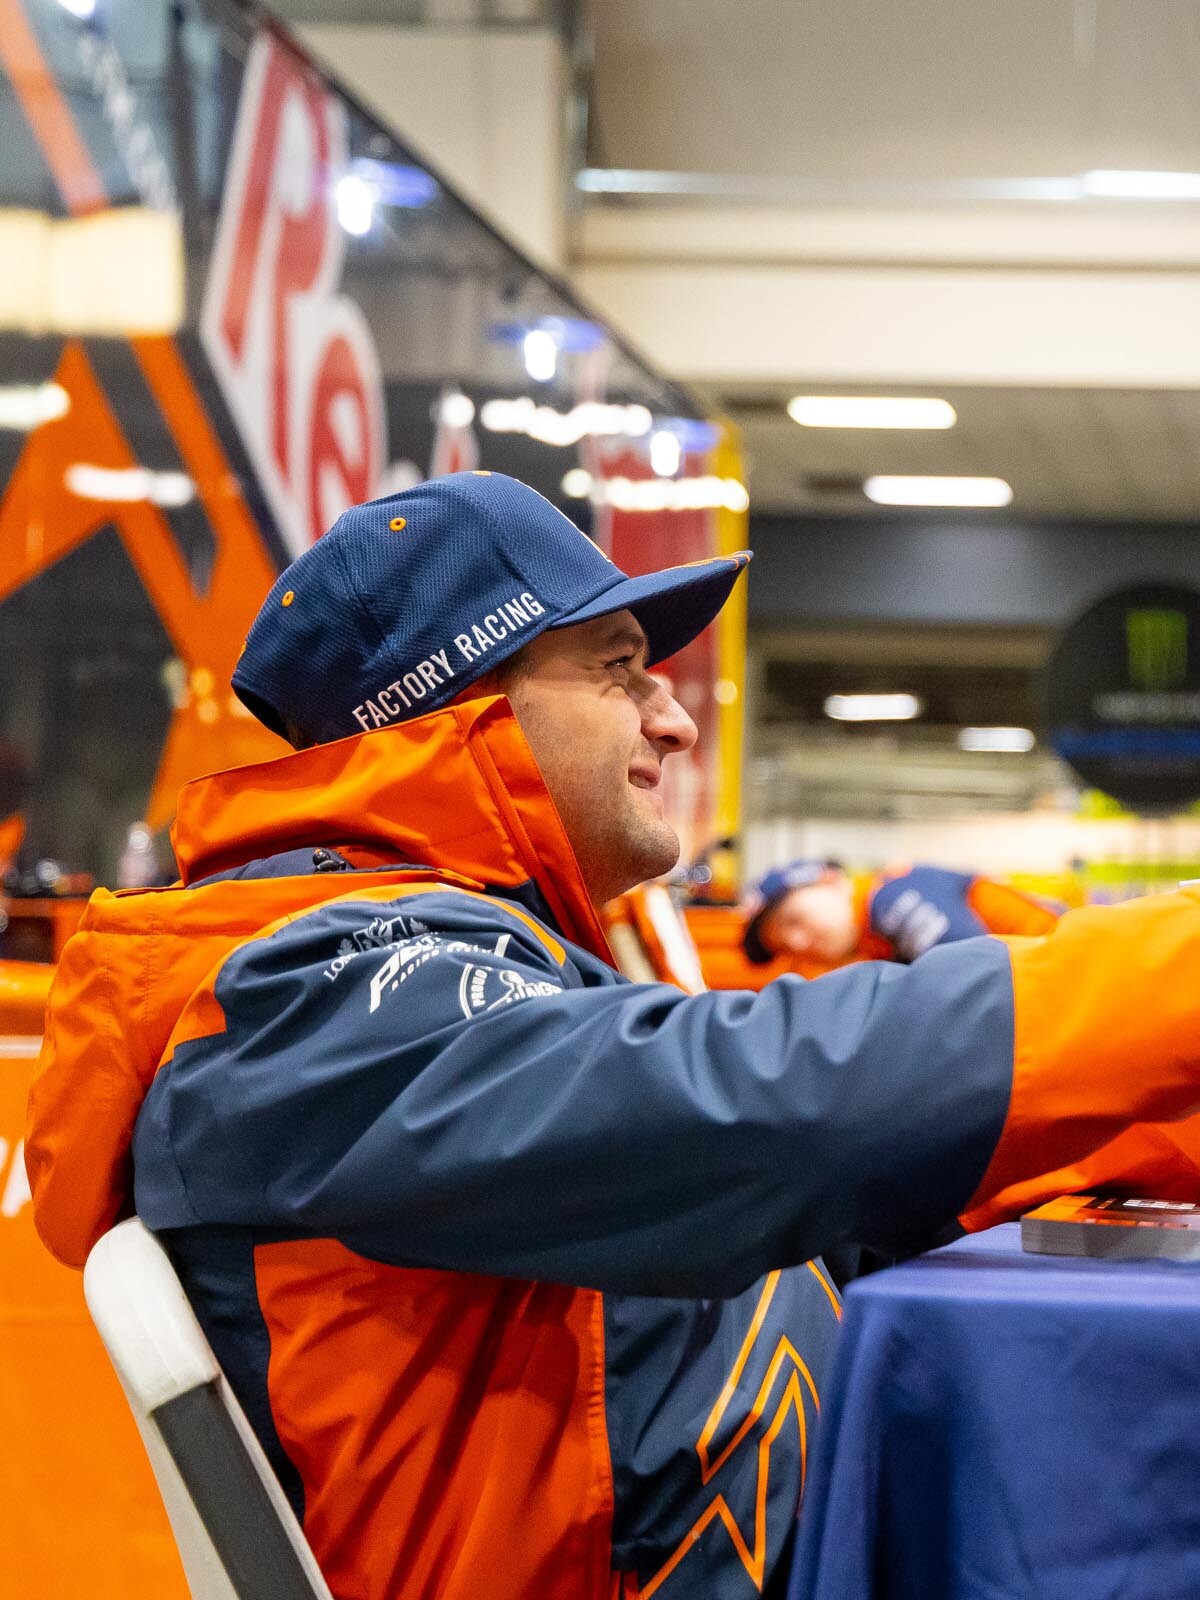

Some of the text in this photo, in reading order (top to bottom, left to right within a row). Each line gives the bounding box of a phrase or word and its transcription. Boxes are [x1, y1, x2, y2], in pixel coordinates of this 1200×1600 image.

[352, 592, 546, 731] FACTORY RACING
[471, 968, 488, 1007] PROUD
